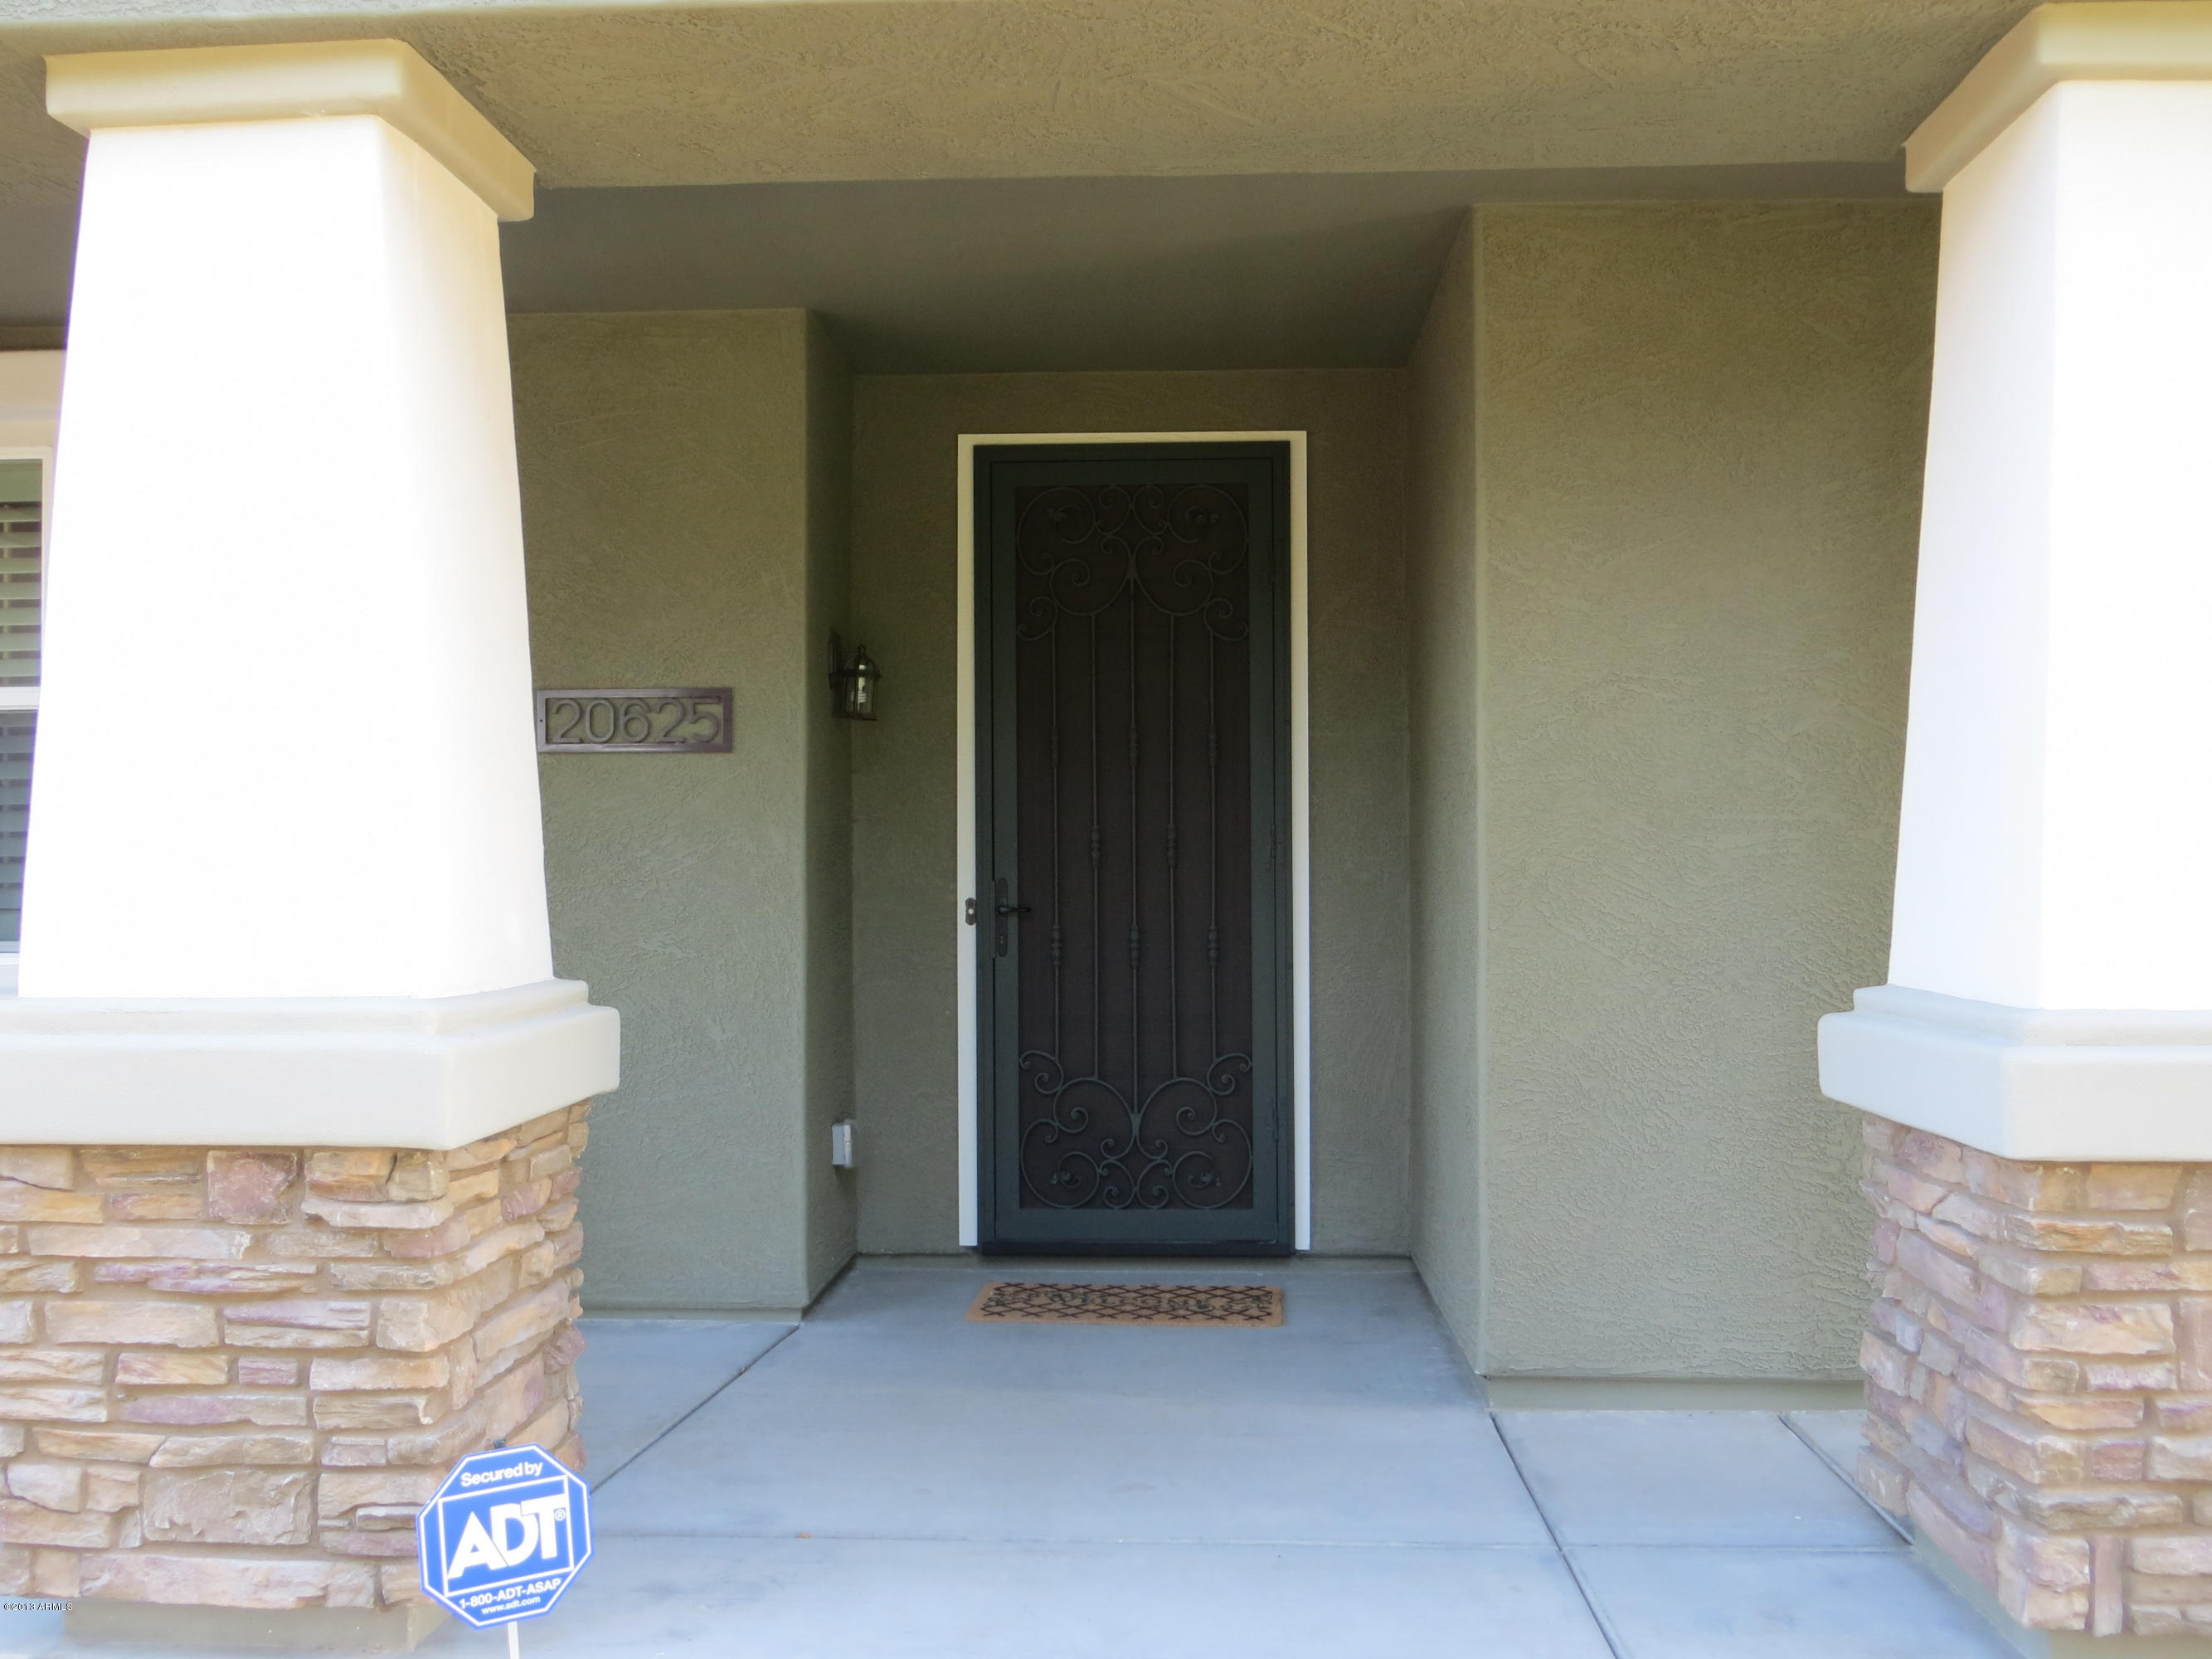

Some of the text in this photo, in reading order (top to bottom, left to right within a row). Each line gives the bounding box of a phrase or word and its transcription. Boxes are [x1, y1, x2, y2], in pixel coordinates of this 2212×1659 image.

[551, 697, 720, 744] 20625
[460, 1462, 543, 1487] Secured by
[447, 1493, 566, 1579] ADT
[459, 1578, 562, 1609] 1-800-ADT-ASAP
[481, 1595, 541, 1615] www.adt.com
